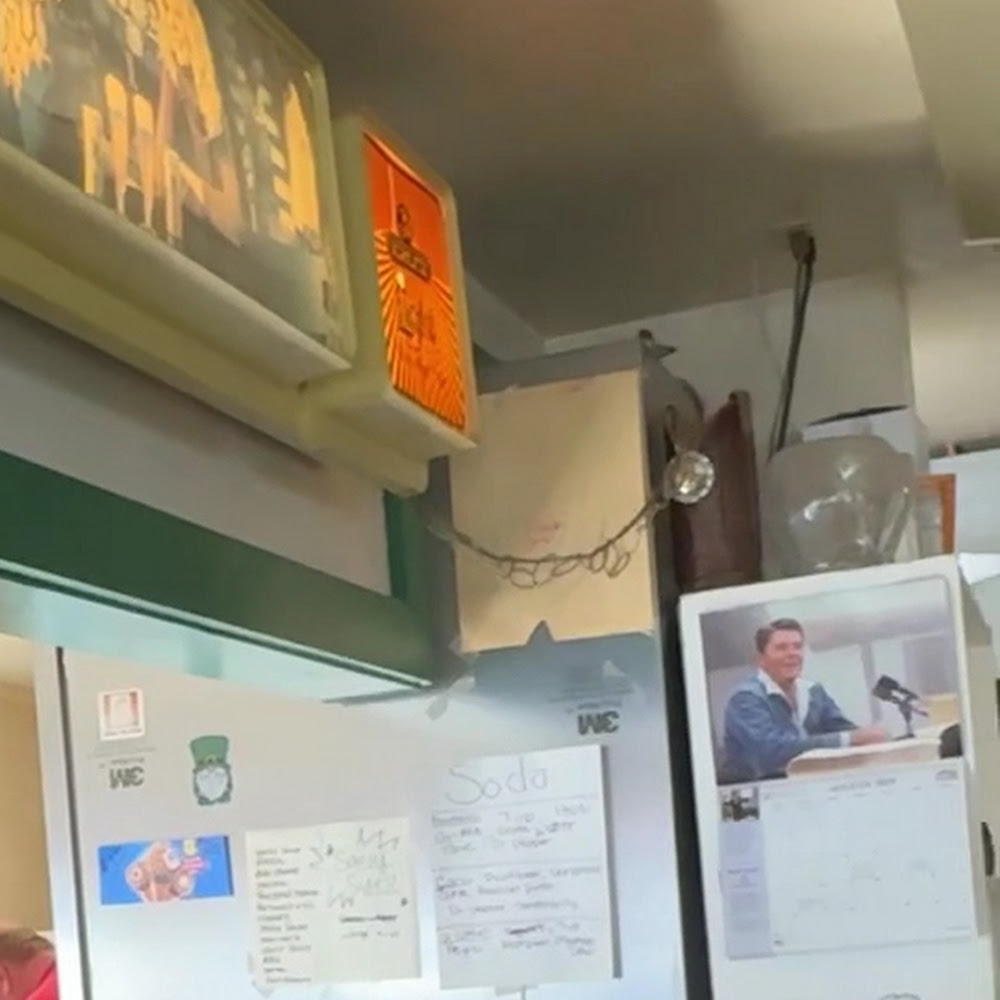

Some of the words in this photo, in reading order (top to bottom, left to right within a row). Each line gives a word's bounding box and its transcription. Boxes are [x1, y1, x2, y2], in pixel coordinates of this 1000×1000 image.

[578, 711, 620, 735] 3M
[109, 766, 145, 789] 3M
[444, 757, 548, 805] Soda
